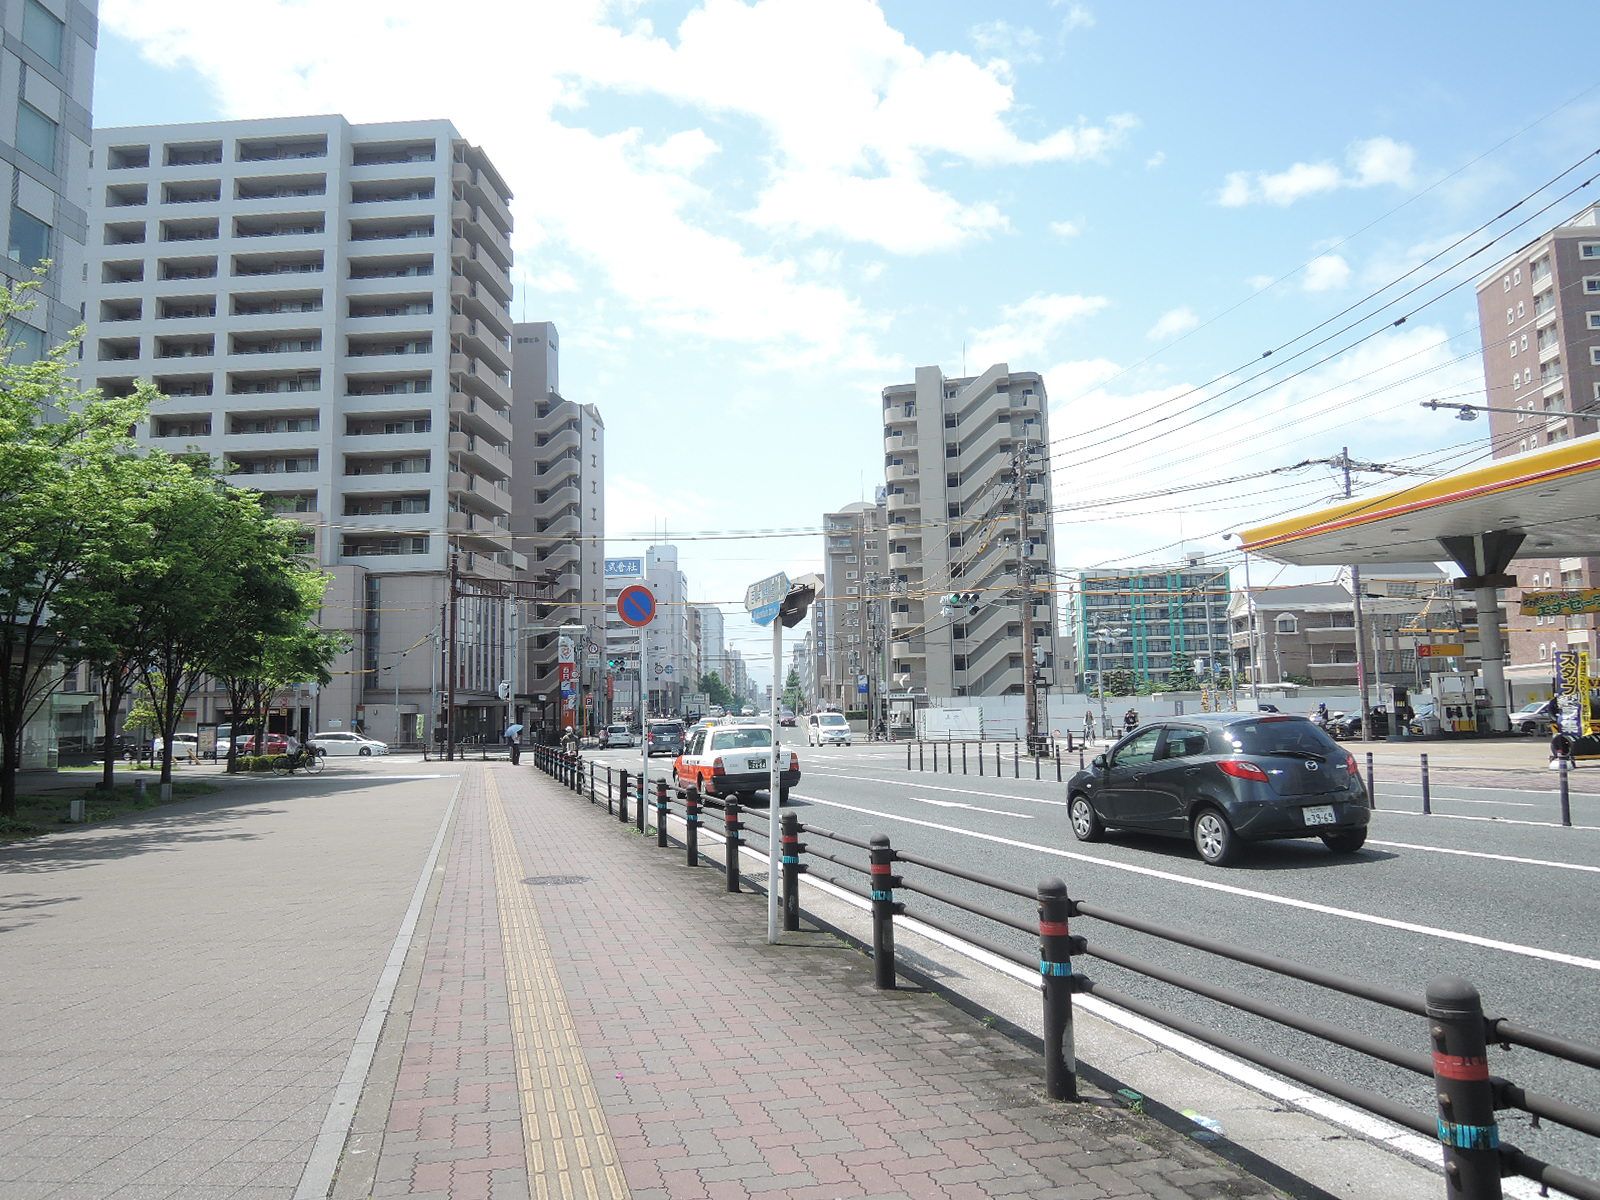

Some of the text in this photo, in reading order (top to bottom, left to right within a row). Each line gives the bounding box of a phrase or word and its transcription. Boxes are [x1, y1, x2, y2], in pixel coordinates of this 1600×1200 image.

[605, 561, 637, 573] 式會社
[1422, 647, 1429, 656] 2
